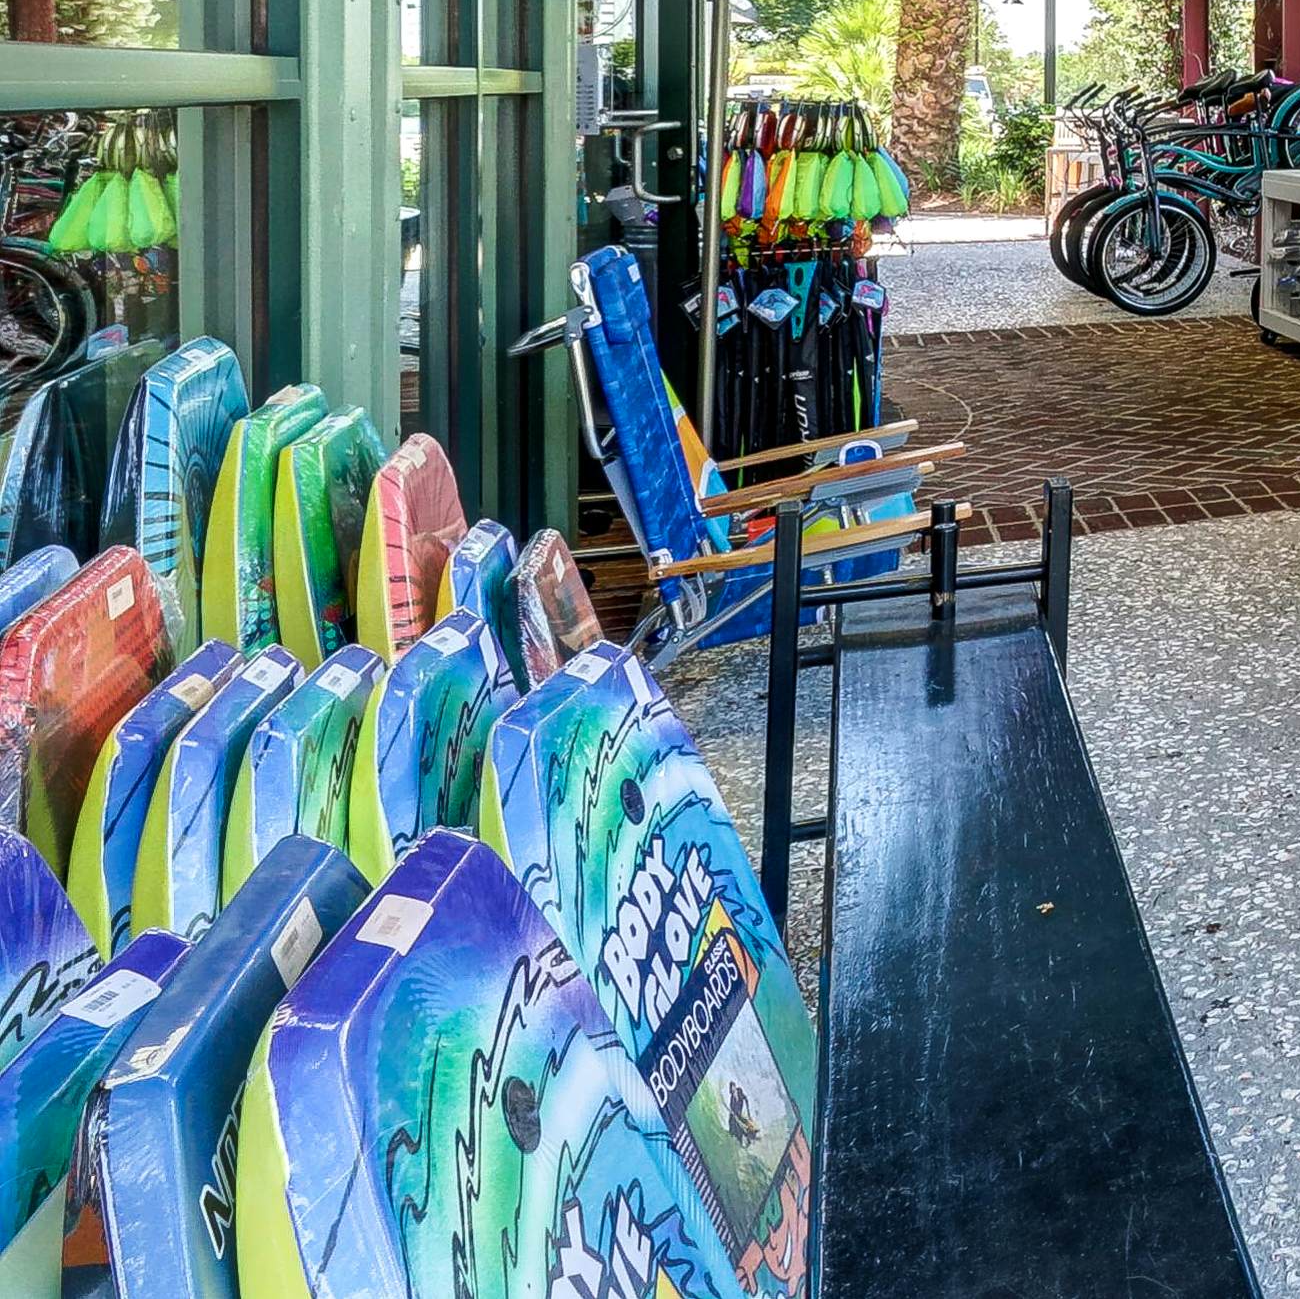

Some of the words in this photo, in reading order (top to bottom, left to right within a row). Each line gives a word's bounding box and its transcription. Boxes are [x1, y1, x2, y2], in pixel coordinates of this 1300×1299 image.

[602, 836, 677, 1024] BODY
[644, 846, 714, 1034] GLOVE
[649, 953, 739, 1108] BODYBOARDS
